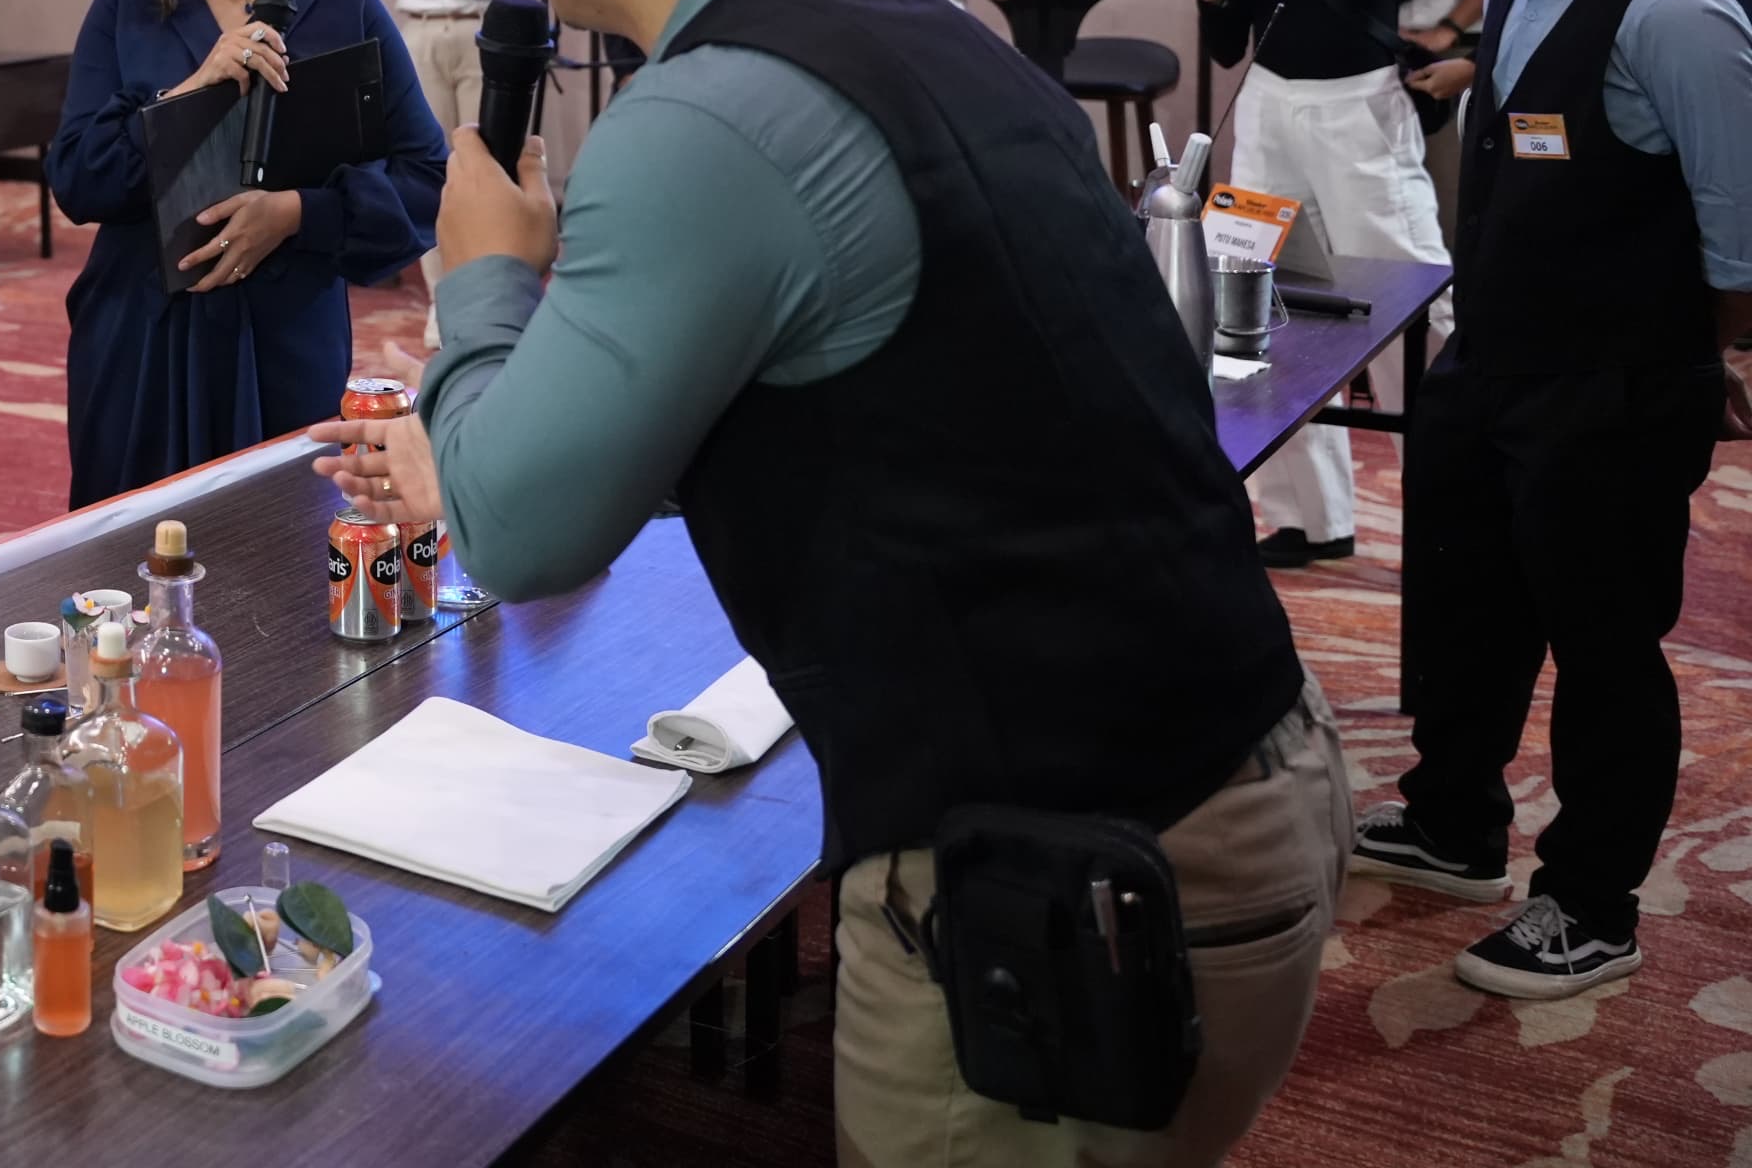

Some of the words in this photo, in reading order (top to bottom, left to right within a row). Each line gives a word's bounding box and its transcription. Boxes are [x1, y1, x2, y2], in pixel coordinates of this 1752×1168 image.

[329, 555, 349, 576] aris
[126, 1014, 159, 1036] APPLE
[162, 1026, 220, 1056] BLOSSOM
